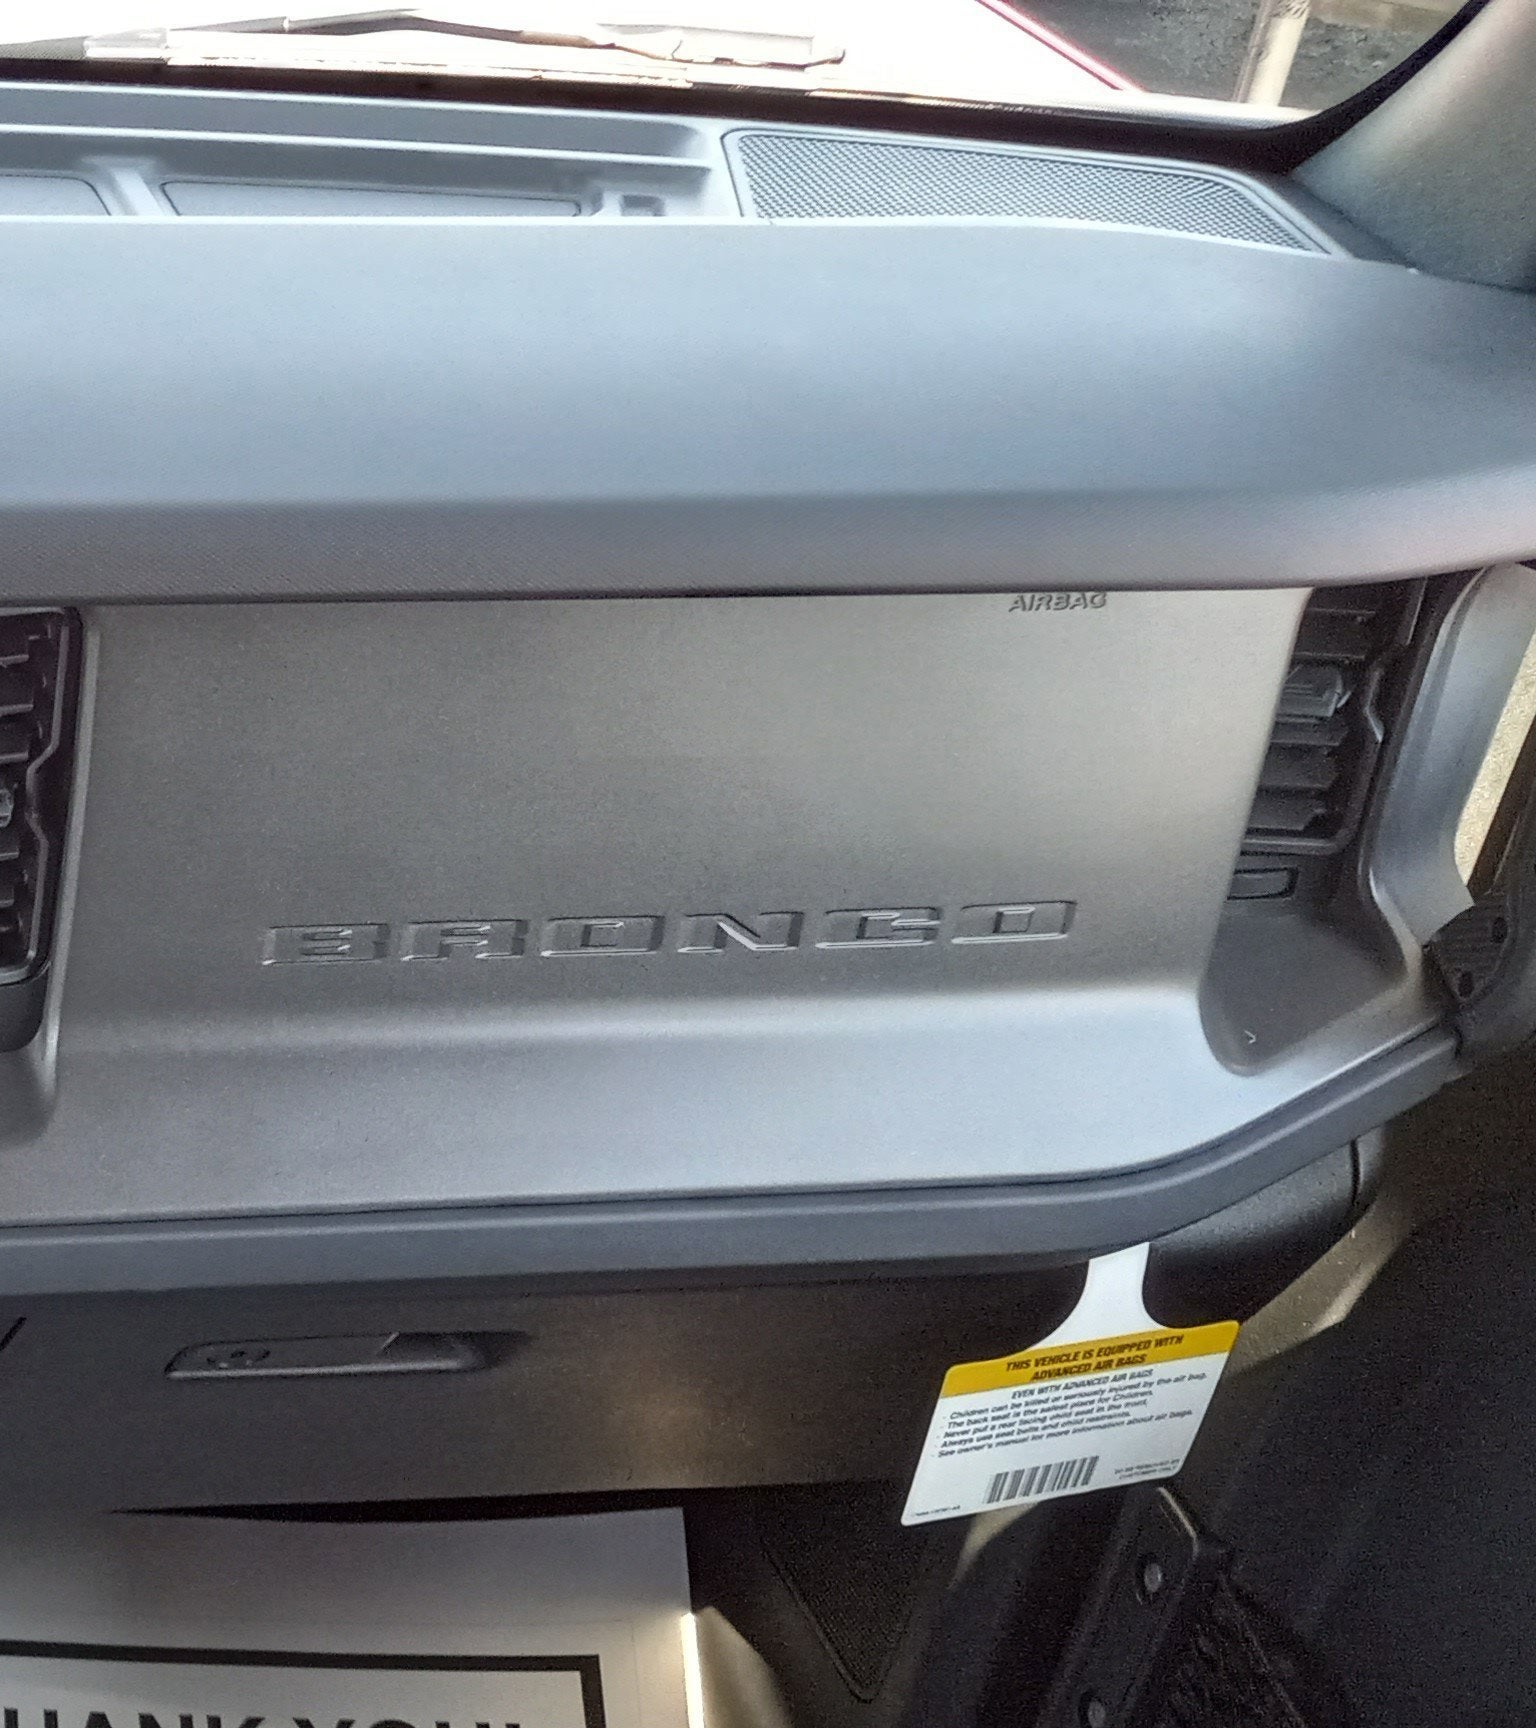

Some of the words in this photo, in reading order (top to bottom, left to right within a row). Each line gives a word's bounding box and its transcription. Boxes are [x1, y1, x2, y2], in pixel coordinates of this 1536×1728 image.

[1008, 591, 1107, 612] AIRBAG
[263, 900, 1077, 965] BRONCO
[1006, 1357, 1031, 1372] THIS
[1034, 1351, 1079, 1368] VEHICLE
[1096, 1341, 1152, 1358] EQUIPPED
[1032, 1363, 1091, 1381] ADVANCED
[1093, 1357, 1113, 1371] AIR
[1115, 1353, 1148, 1369] BAGS
